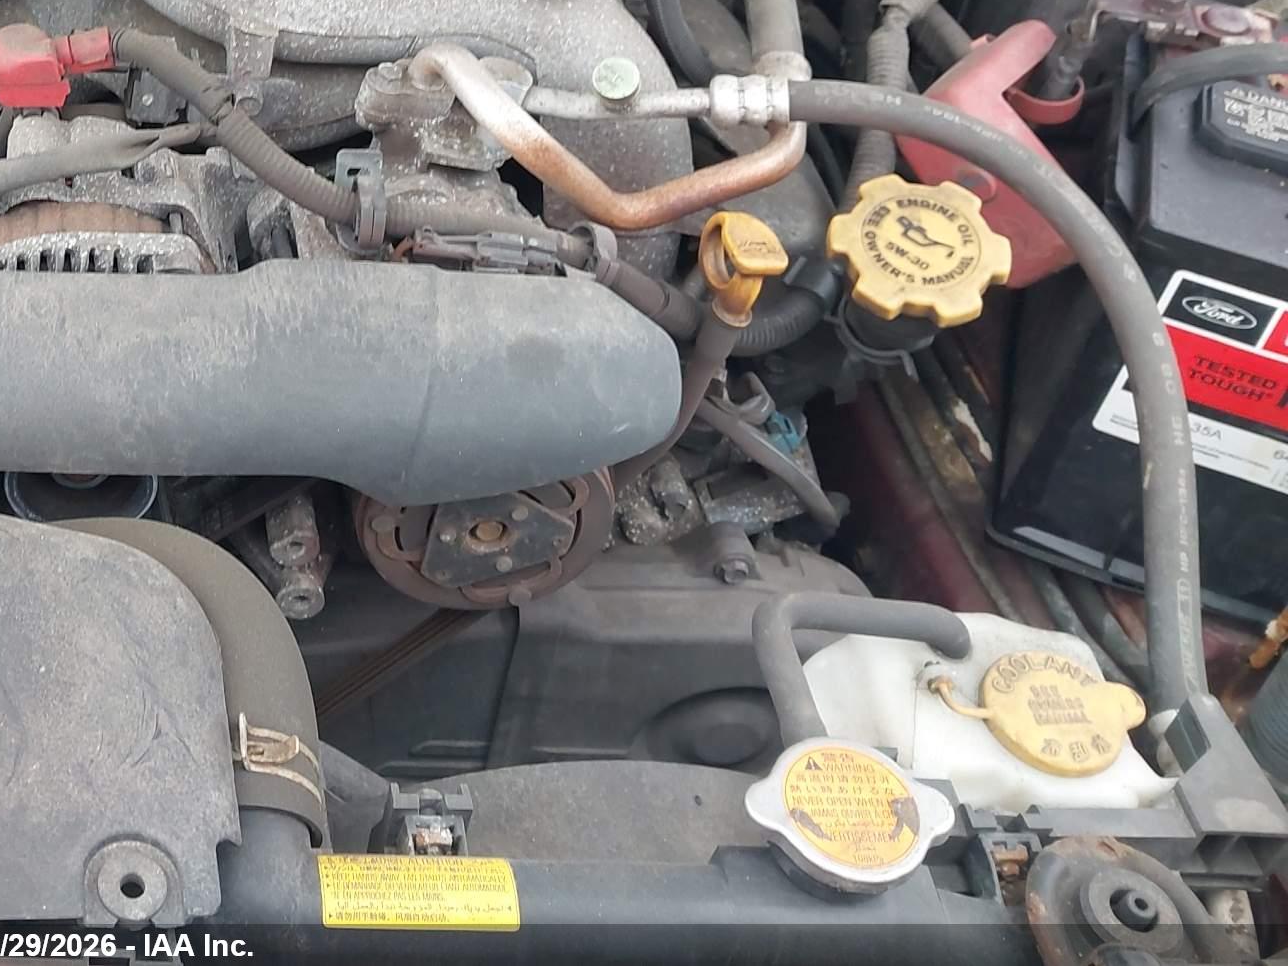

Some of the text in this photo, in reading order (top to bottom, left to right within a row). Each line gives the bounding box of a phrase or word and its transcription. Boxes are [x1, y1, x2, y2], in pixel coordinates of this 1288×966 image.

[895, 197, 974, 247] ENGINE OIL
[864, 230, 916, 284] OWNER'S
[921, 256, 975, 286] MANUAL
[885, 241, 931, 271] 5W-30
[1192, 299, 1246, 326] Ford
[1193, 353, 1278, 391] TESTED
[991, 654, 1098, 694] COOLANT
[823, 763, 876, 774] WARNING
[792, 795, 824, 807] NEVER
[825, 796, 853, 808] OPEN
[854, 796, 884, 809] WHEN
